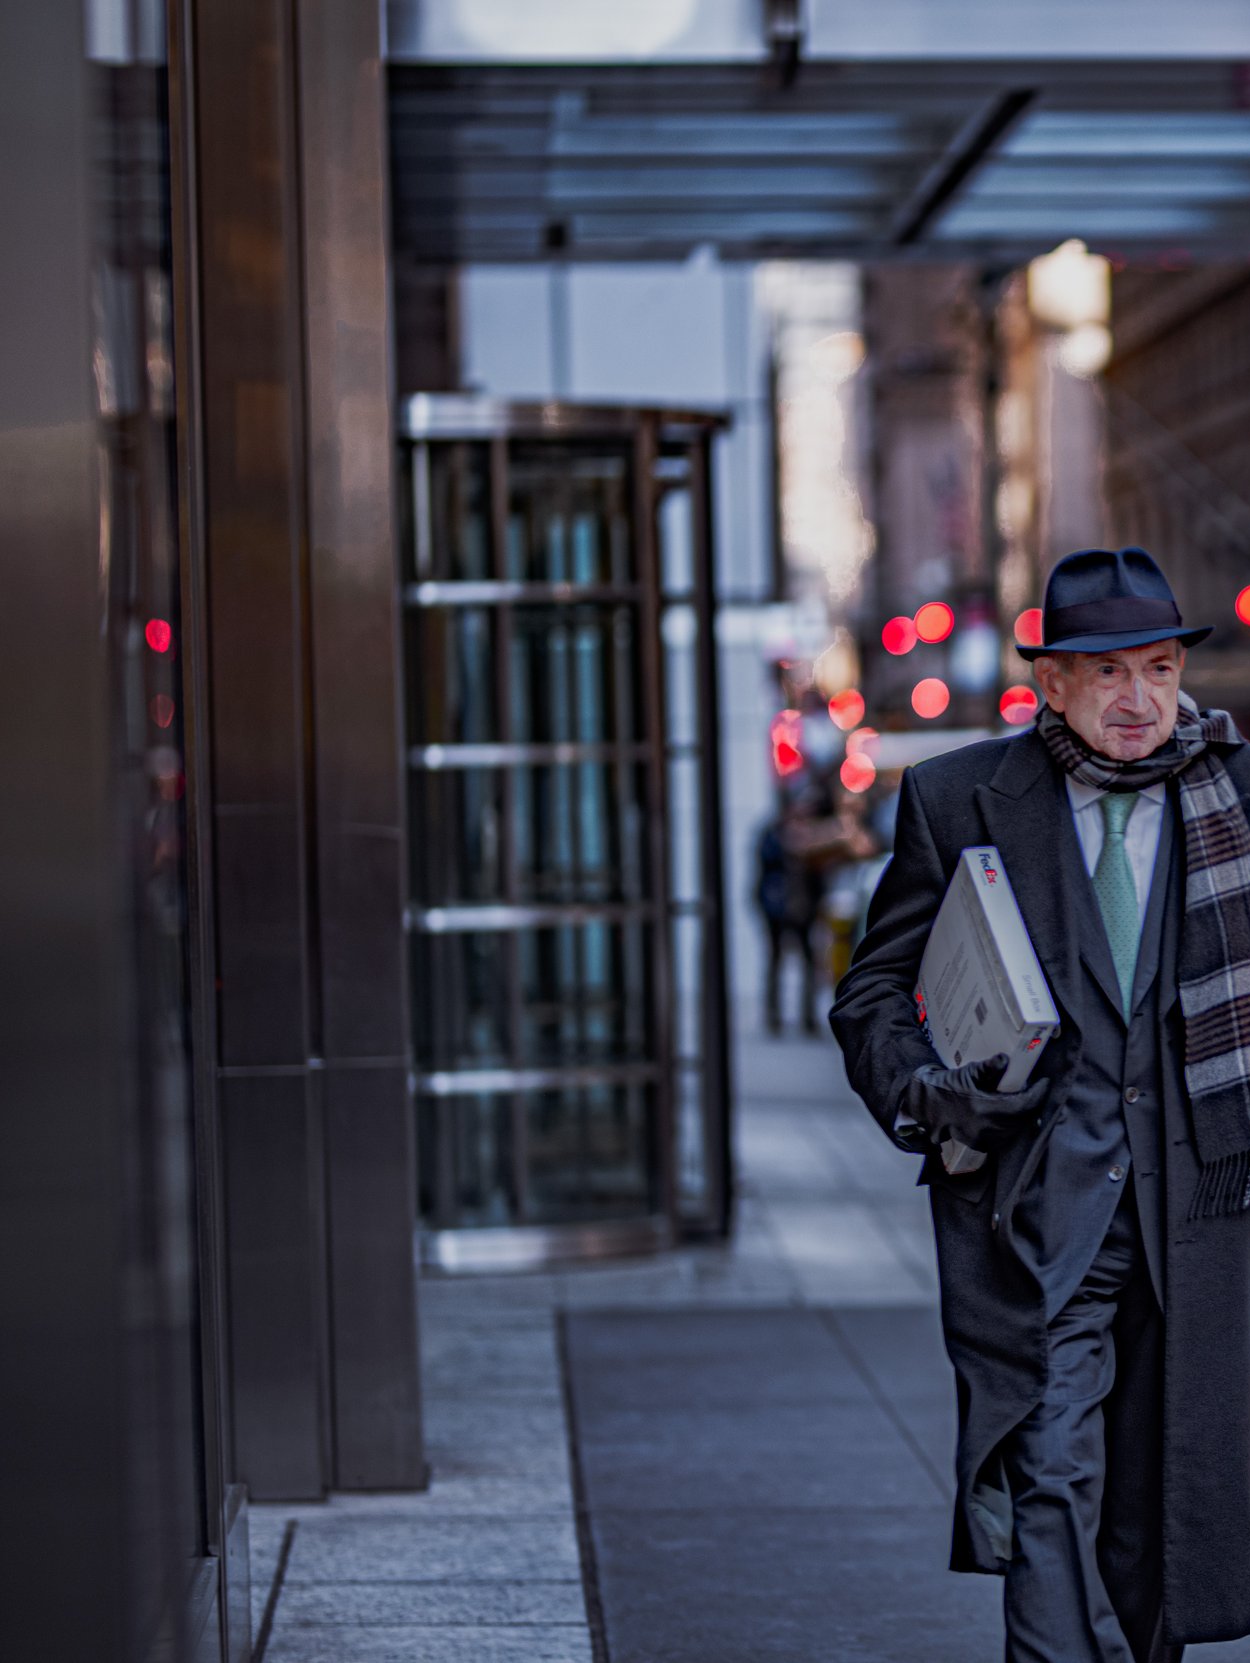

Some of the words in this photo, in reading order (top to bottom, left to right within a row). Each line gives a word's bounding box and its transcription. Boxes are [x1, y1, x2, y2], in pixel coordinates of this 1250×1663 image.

[979, 853, 997, 884] FedEx
[1022, 973, 1037, 996] Small
[1031, 997, 1041, 1013] Box
